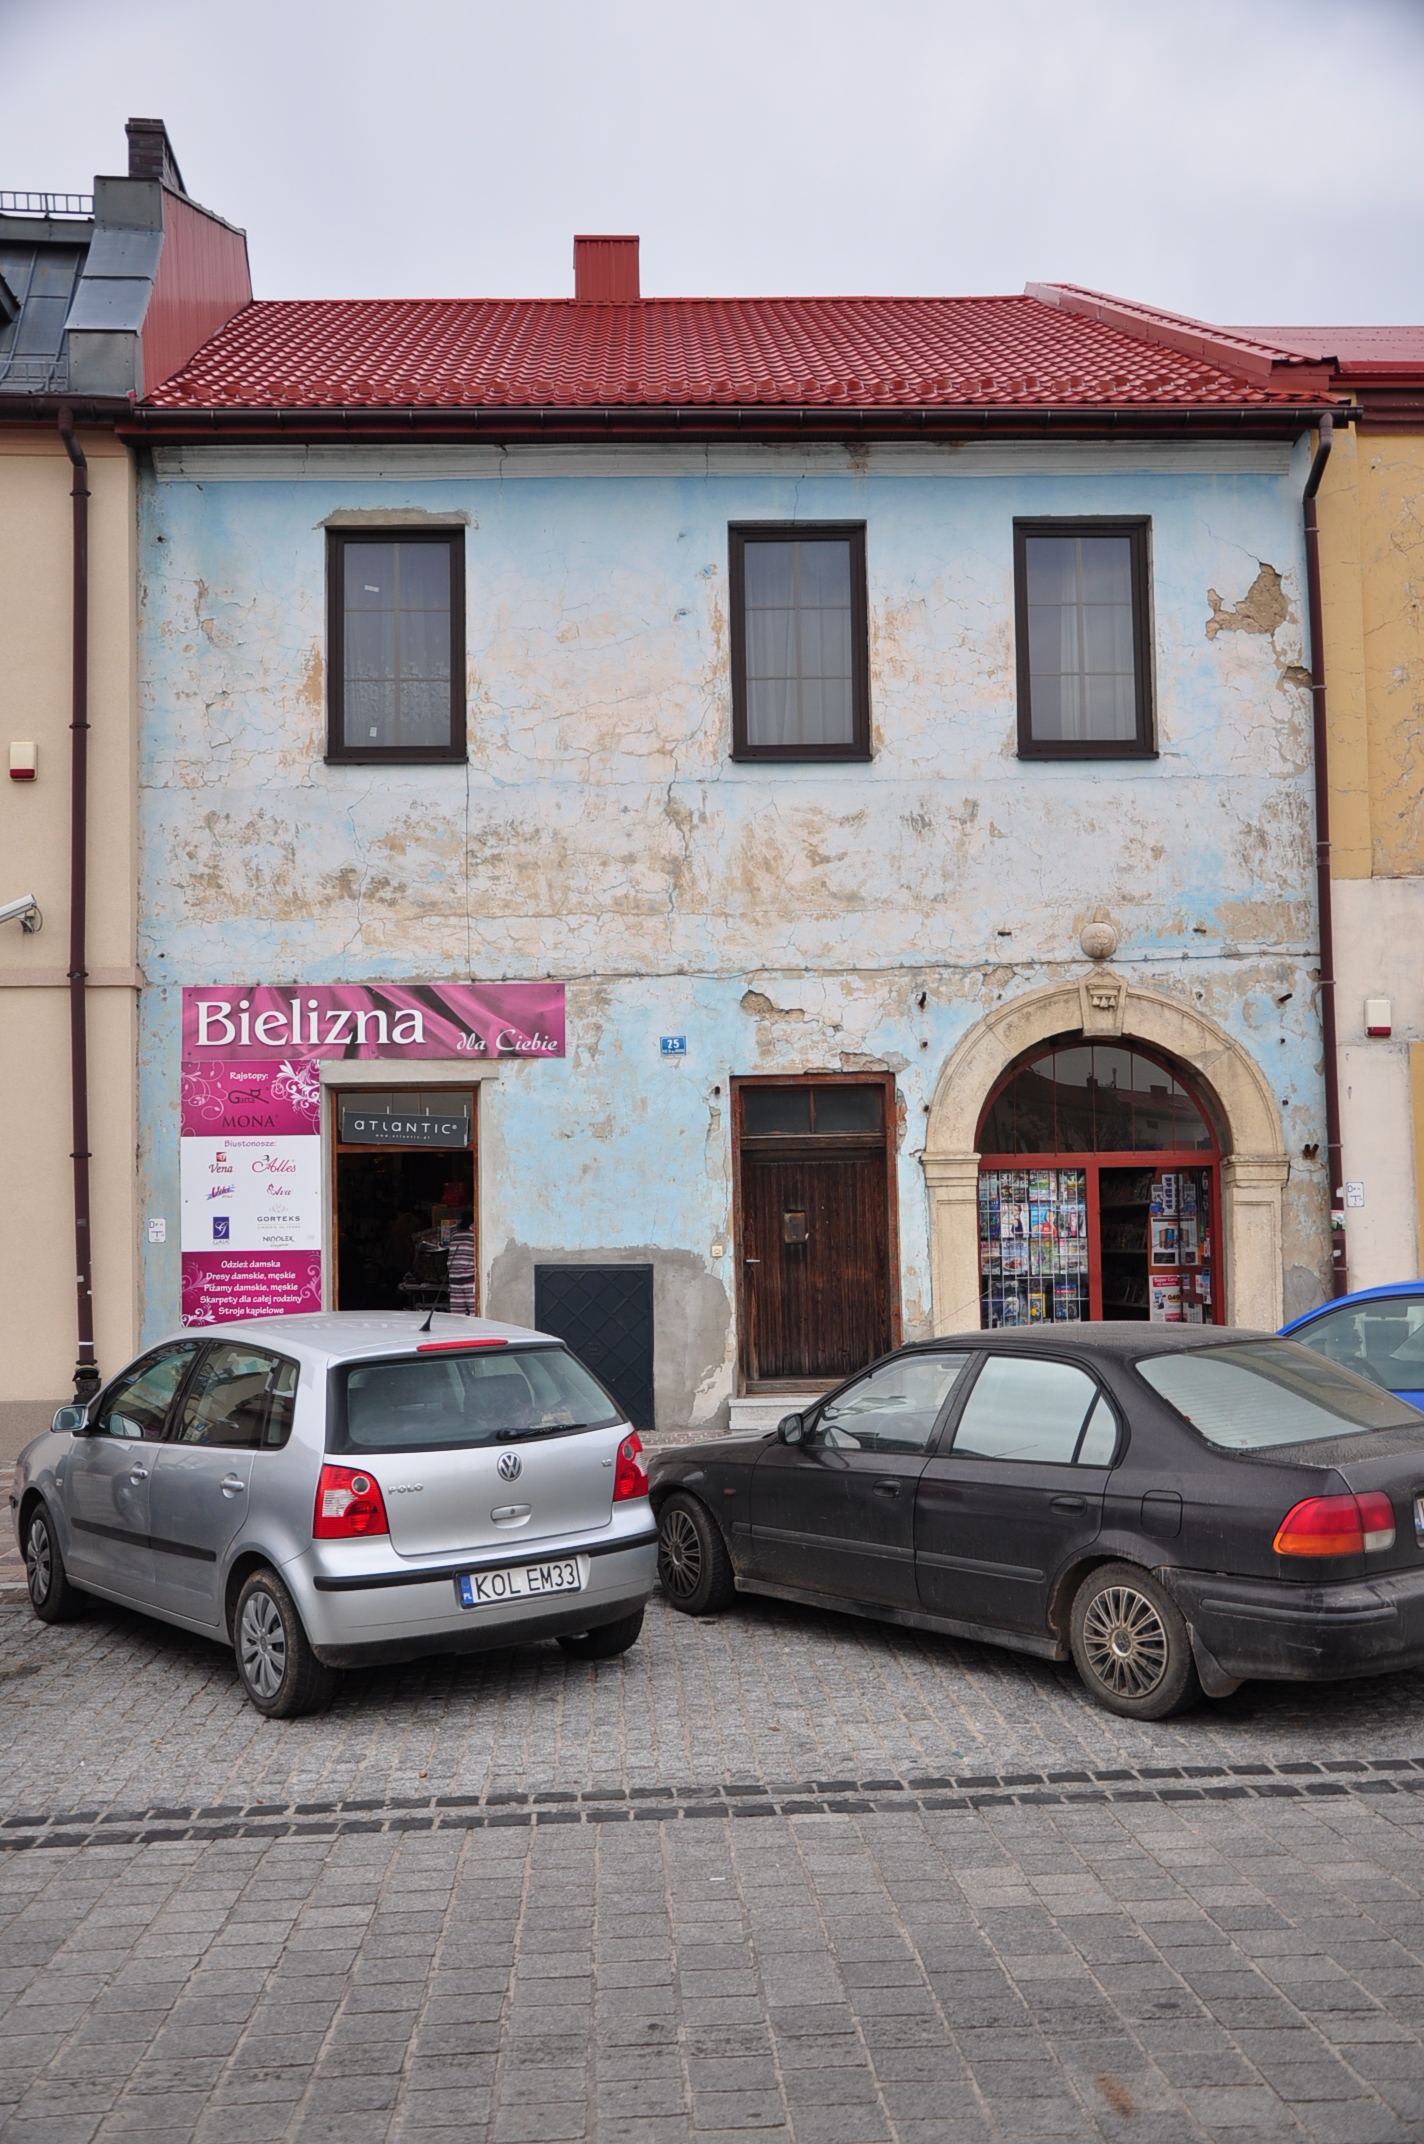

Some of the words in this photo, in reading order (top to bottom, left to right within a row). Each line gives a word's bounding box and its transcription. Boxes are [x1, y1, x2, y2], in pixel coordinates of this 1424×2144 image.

[195, 998, 426, 1046] Bielizna
[455, 1032, 486, 1050] dla
[495, 1029, 558, 1051] Ciebie
[229, 1071, 269, 1082] Rajstopy:
[222, 1115, 275, 1128] MONA
[208, 1163, 233, 1173] Vena
[221, 1260, 248, 1269] Odzież
[249, 1260, 281, 1268] damska
[206, 1272, 230, 1281] Dresy
[231, 1271, 267, 1280] damskie,
[268, 1271, 296, 1281] męskie
[233, 1283, 269, 1292] damskie,
[270, 1283, 298, 1293] męskie
[200, 1295, 238, 1305] Skarpety
[239, 1295, 251, 1303] dla
[252, 1295, 272, 1304] całej
[273, 1294, 302, 1303] rodziny
[218, 1306, 245, 1316] Stroje
[388, 1482, 424, 1495] POLO
[475, 1571, 521, 1600] KOL
[526, 1563, 576, 1592] EM33
